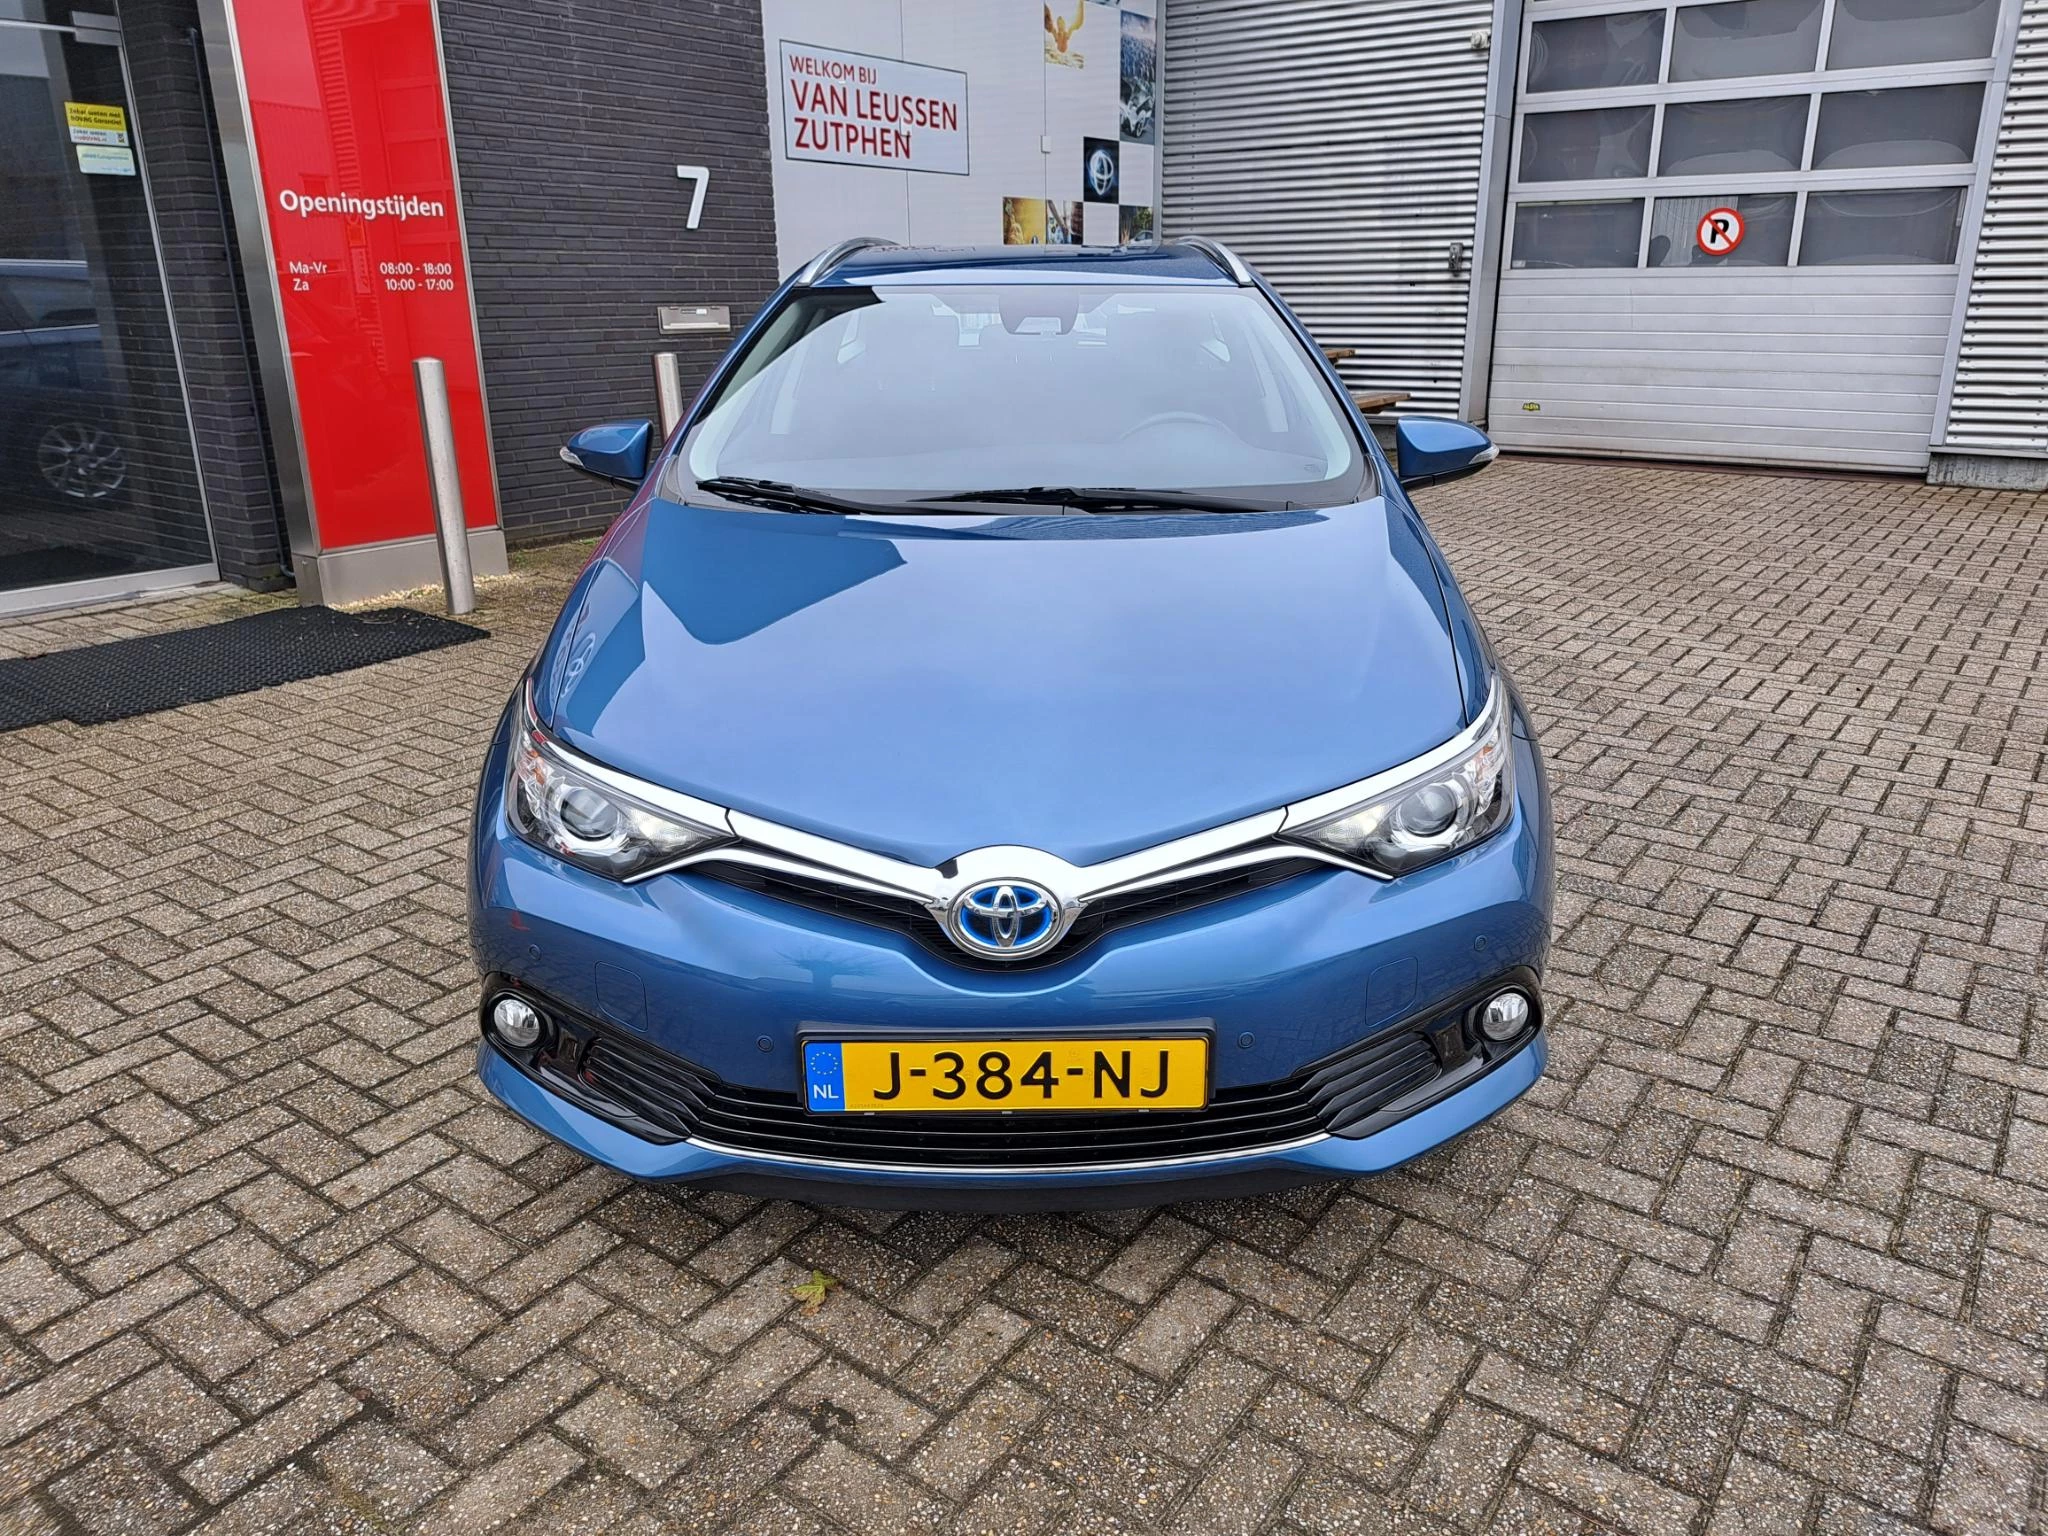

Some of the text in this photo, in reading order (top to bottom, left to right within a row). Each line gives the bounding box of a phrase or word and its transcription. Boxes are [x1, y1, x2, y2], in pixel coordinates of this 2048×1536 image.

[789, 54, 877, 85] WELKOM BIJ
[790, 79, 957, 131] VAN LEUSSEN
[794, 117, 911, 159] ZUTPHEN
[280, 189, 444, 221] Openingstijden
[676, 164, 710, 229] 7
[1710, 219, 1729, 244] P
[289, 261, 327, 275] Ma-Vr
[379, 262, 413, 275] 08:00
[423, 263, 452, 275] 18:00
[293, 278, 310, 291] Za
[385, 278, 415, 291] 10:00
[426, 279, 454, 291] 17:00
[813, 1050, 1169, 1101] NL J-384-NJ
